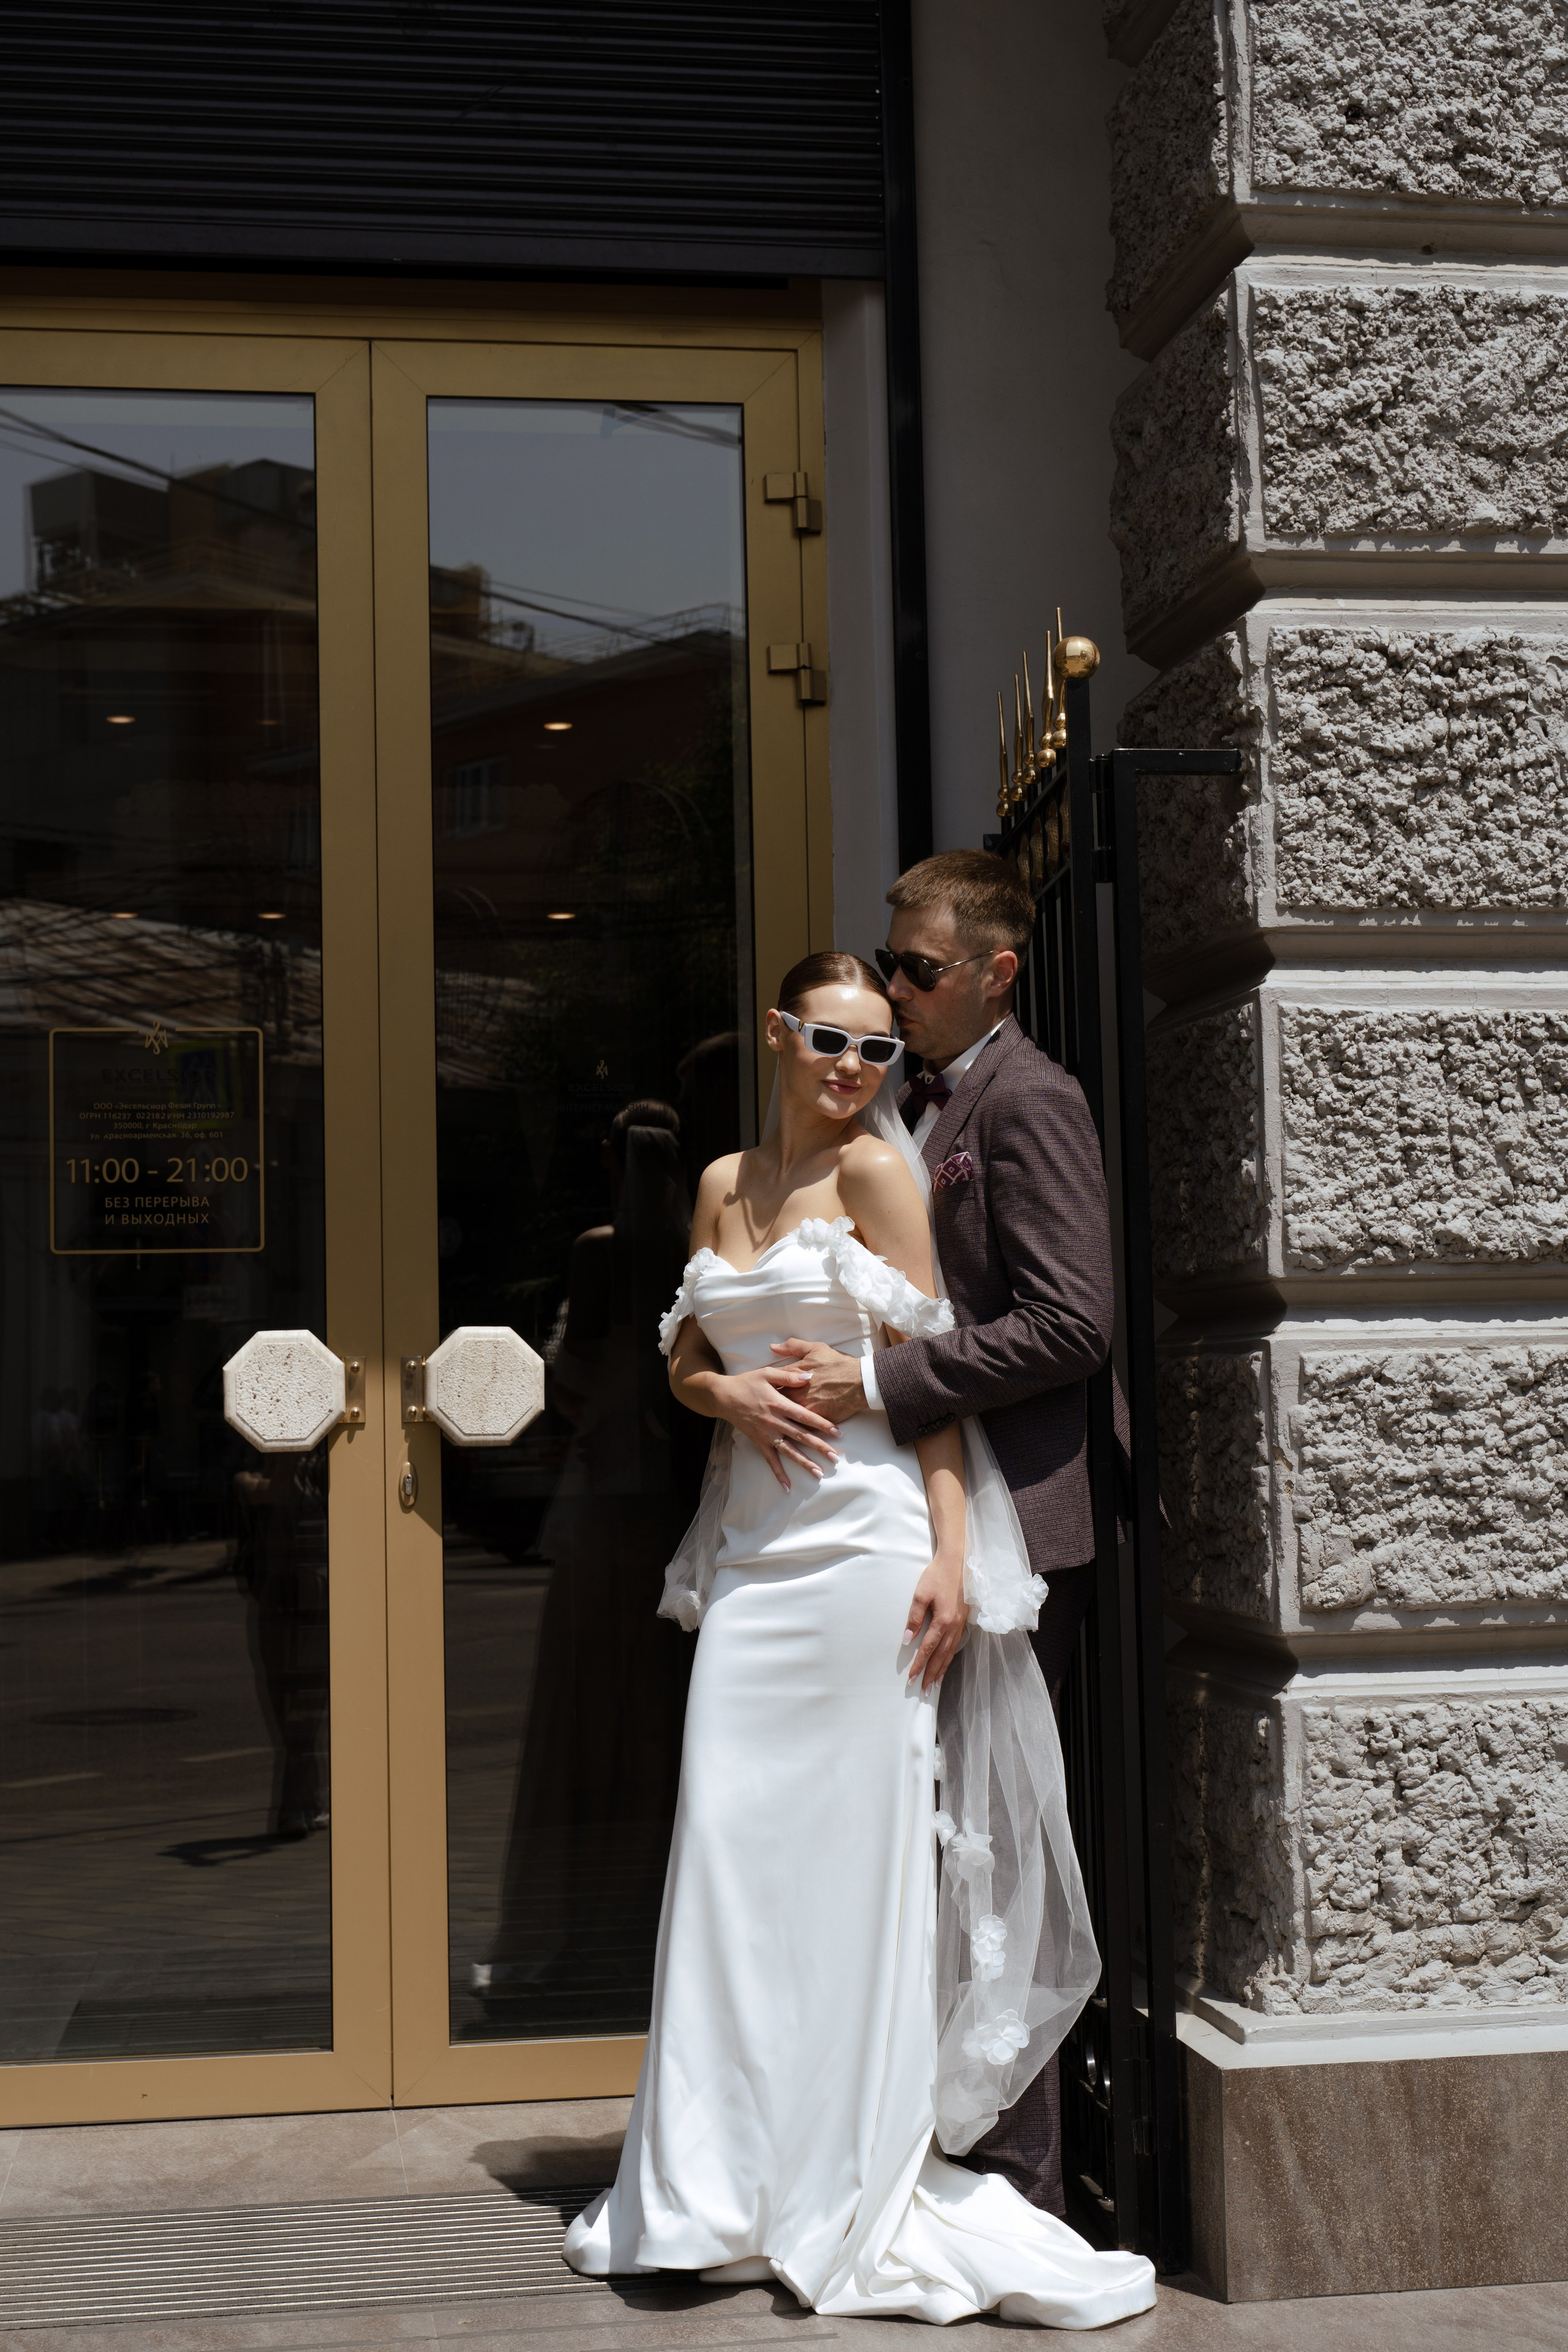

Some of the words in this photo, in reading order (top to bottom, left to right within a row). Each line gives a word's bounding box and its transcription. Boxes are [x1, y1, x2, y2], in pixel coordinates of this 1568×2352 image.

[101, 1068, 216, 1083] EXCELSIOR
[568, 1083, 635, 1092] EXCELSIOR
[187, 1111, 235, 1120] 2310192987
[66, 1158, 140, 1183] 11:00
[167, 1157, 248, 1183] 21:00
[105, 1197, 130, 1208] БЕЗ
[135, 1196, 210, 1208] ПЕРЕРЫВА
[105, 1214, 115, 1225] И
[122, 1213, 209, 1226] ВЫХОДНЫХ
